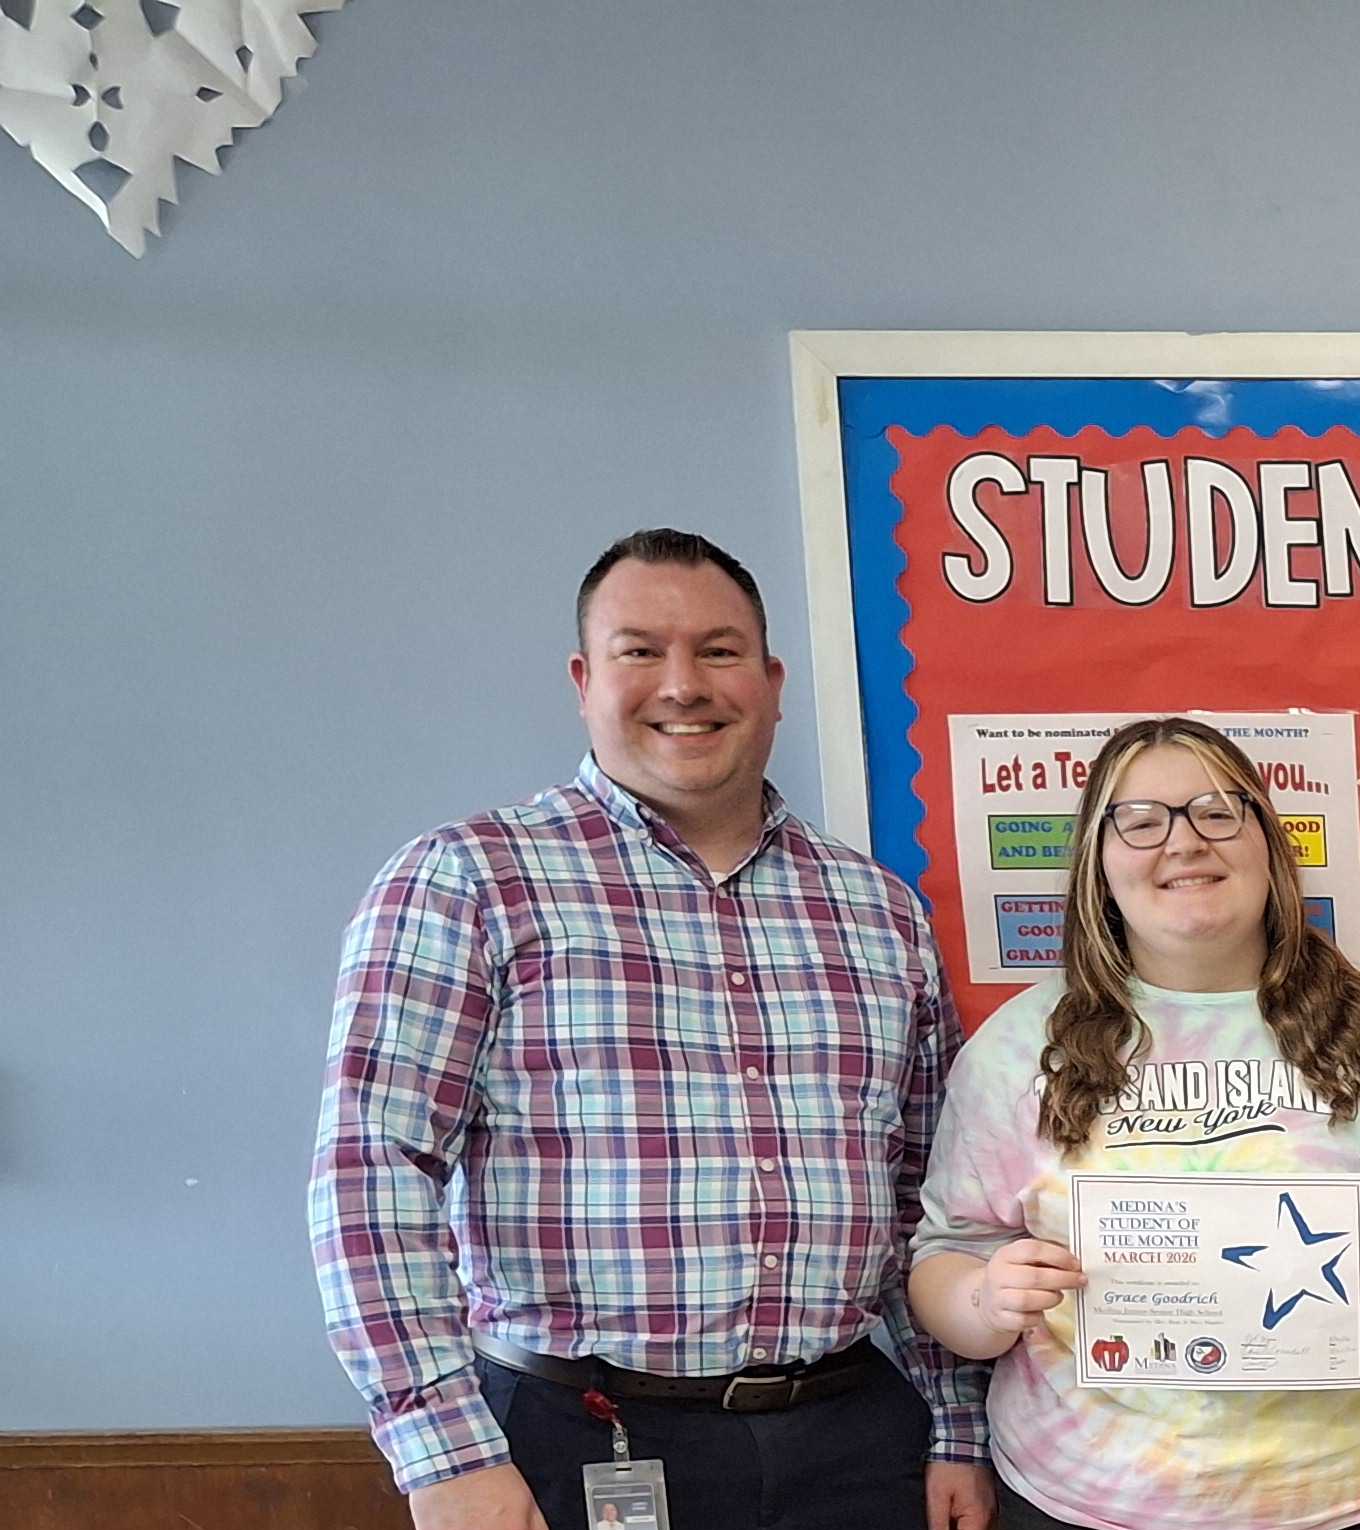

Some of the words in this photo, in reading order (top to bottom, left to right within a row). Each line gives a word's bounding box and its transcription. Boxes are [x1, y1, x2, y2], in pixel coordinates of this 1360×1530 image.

[976, 728, 1009, 739] Want
[1012, 729, 1025, 738] to
[1028, 729, 1042, 738] be
[1045, 728, 1111, 738] nominated
[1224, 727, 1251, 738] THE
[1254, 728, 1310, 738] MONTH?
[981, 754, 1024, 793] Let
[1031, 762, 1048, 790] a
[995, 821, 1053, 833] GOING
[998, 845, 1037, 858] AND
[1107, 1114, 1187, 1136] New
[1193, 1099, 1277, 1136] York
[1110, 1200, 1188, 1214] MEDINA'S
[1098, 1217, 1171, 1231] STUDENT
[1177, 1218, 1201, 1232] OF
[1100, 1234, 1134, 1247] THE
[1138, 1234, 1200, 1248] MONTH
[1104, 1251, 1162, 1264] MARCH
[1166, 1251, 1197, 1264] 2026
[1103, 1290, 1148, 1305] Grace
[1151, 1290, 1219, 1306] Goodrich
